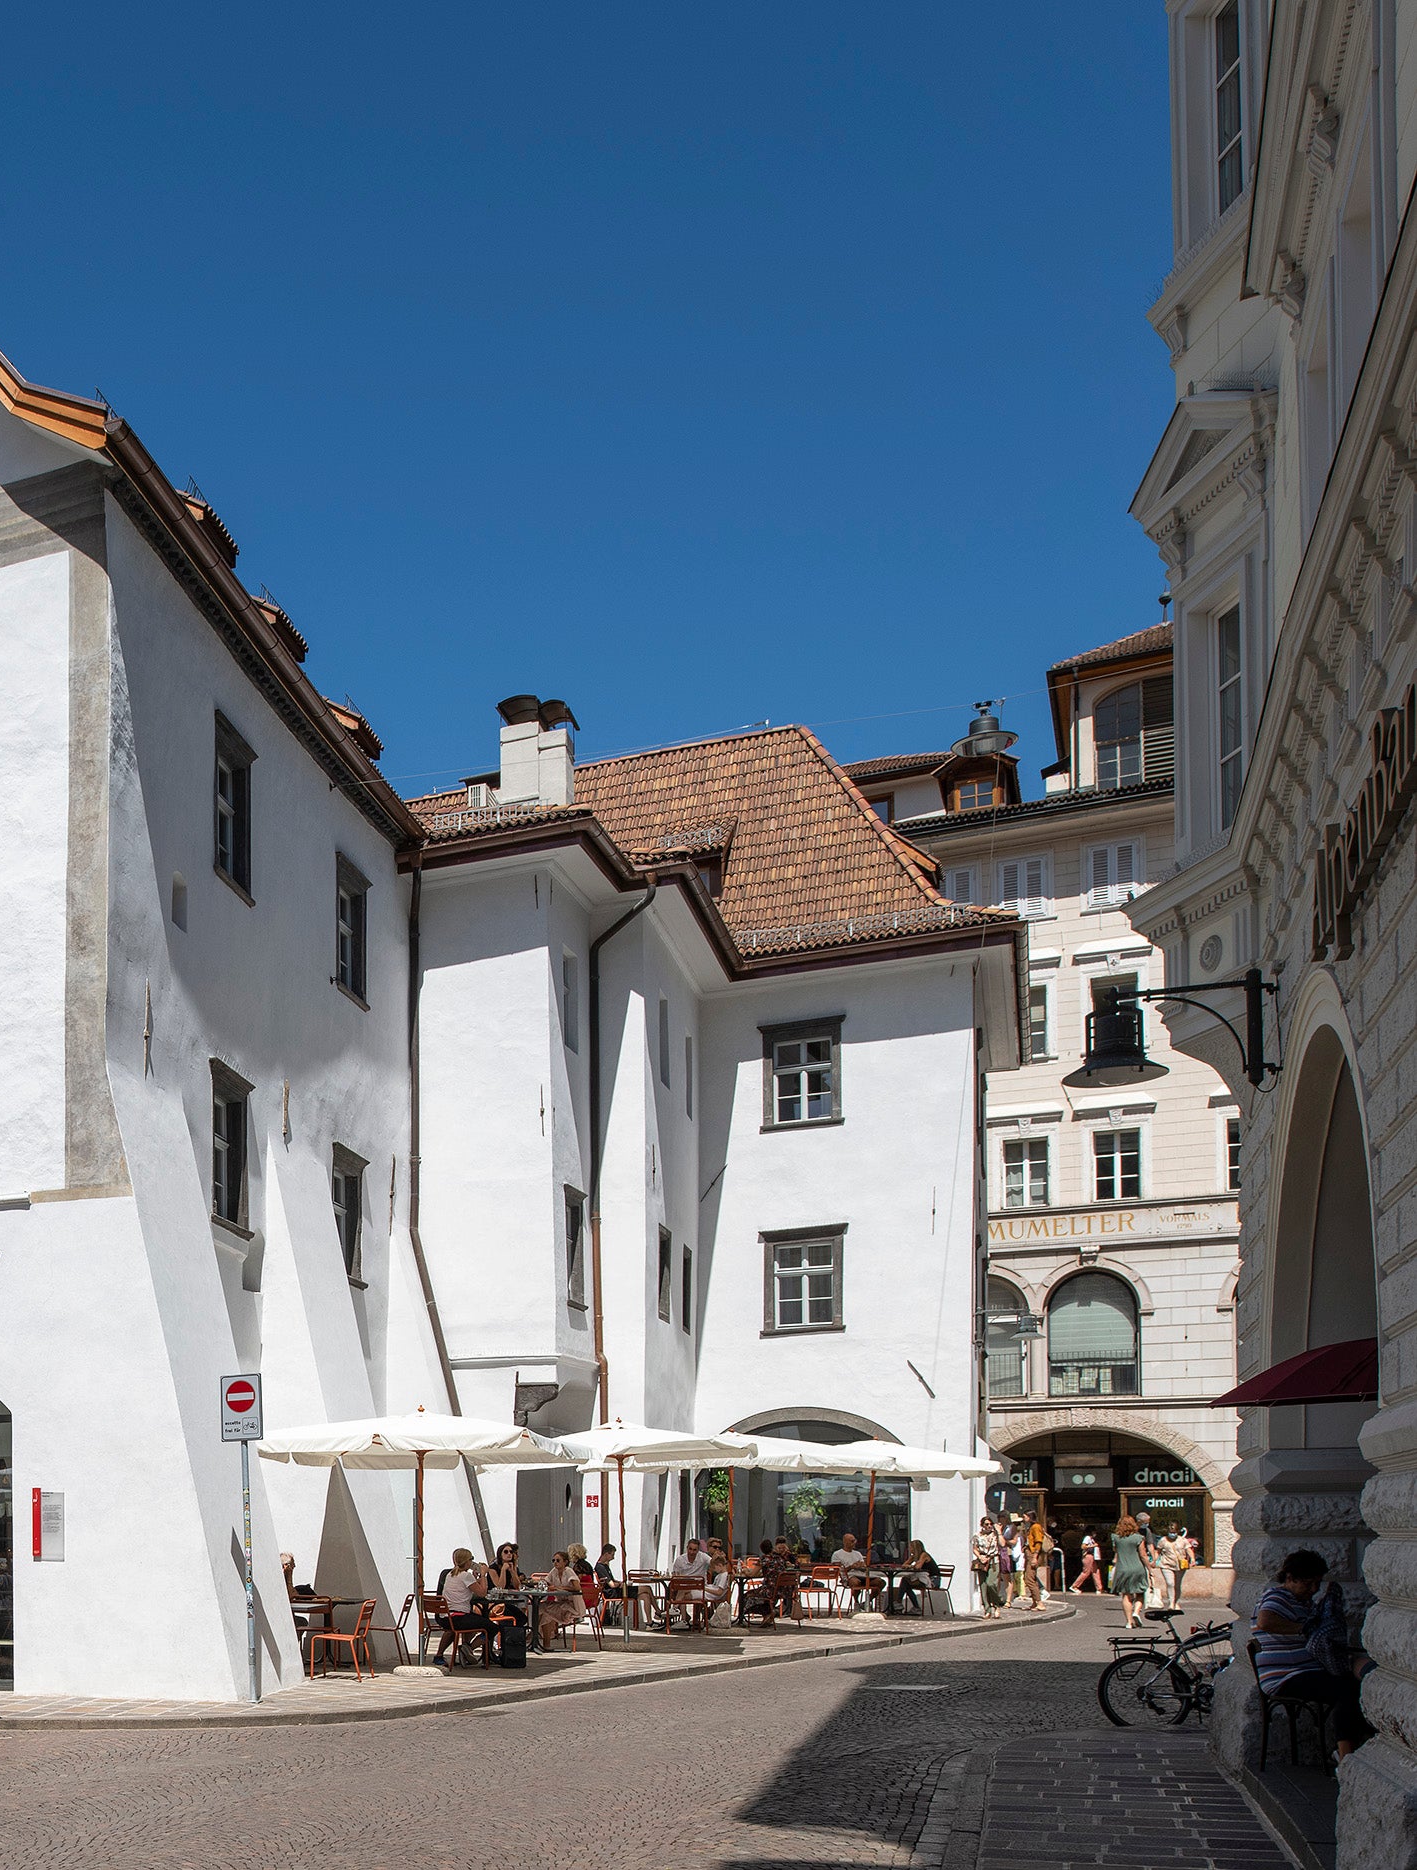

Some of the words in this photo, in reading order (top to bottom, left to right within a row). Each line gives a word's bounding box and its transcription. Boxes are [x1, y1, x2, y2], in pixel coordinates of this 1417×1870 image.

[987, 1212, 1136, 1241] MUMELTER
[1010, 1469, 1034, 1485] ail
[1134, 1467, 1195, 1484] dmail
[1145, 1497, 1184, 1508] dmail
